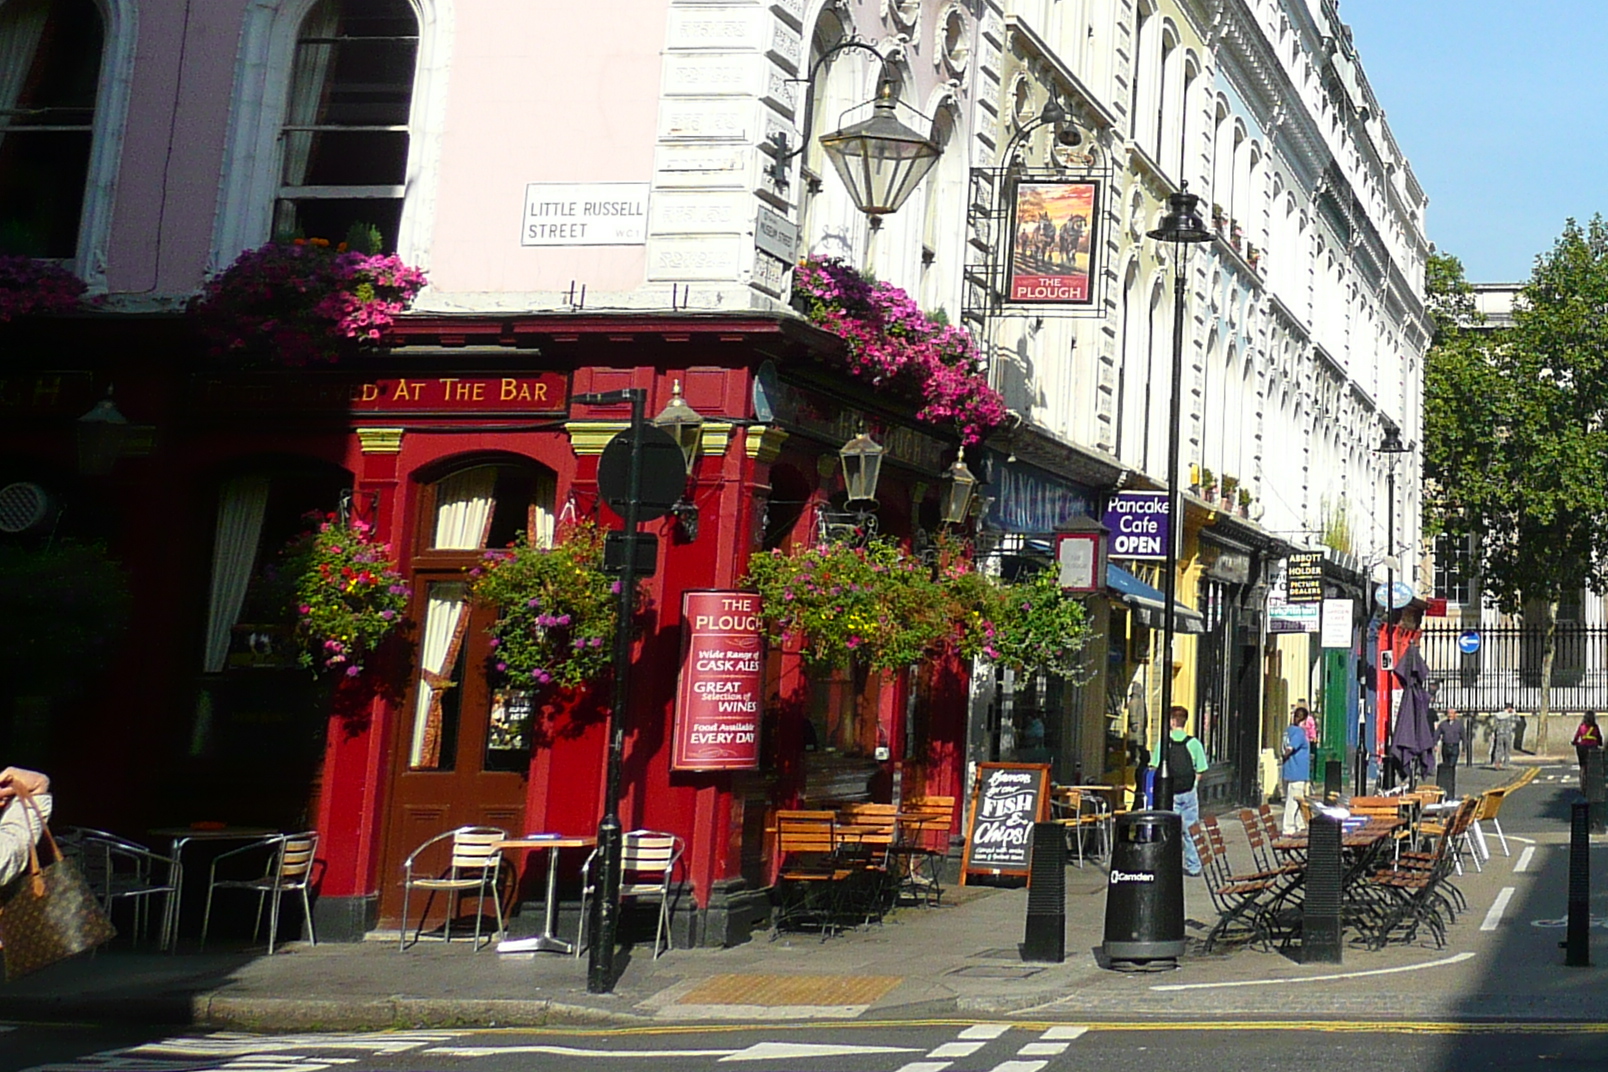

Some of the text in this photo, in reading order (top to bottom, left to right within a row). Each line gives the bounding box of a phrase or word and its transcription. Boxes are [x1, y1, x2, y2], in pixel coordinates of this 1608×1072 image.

[530, 201, 644, 217] LITTLE RUSSELL
[528, 223, 640, 239] STREET WC1
[1038, 278, 1061, 287] THE
[1017, 287, 1081, 298] PLOUGH
[392, 378, 427, 402] AT
[439, 377, 487, 402] THE
[499, 377, 548, 402] BAR
[999, 466, 1063, 533] PANCAKE
[1107, 496, 1170, 514] Pancake
[1119, 515, 1158, 533] Cafe
[1114, 535, 1161, 553] OPEN
[1289, 554, 1322, 563] ABBOTT
[1288, 566, 1322, 575] HOLDER
[721, 599, 752, 612] THE
[695, 615, 763, 630] PLOUGH
[698, 650, 760, 661] Wide Range of
[696, 660, 760, 672] CASK ALES
[693, 681, 742, 693] GREAT
[701, 692, 751, 702] Selection of
[718, 701, 757, 713] WINES
[693, 723, 755, 732] Food Available
[690, 732, 756, 744] EVERY DAY
[981, 793, 1034, 818] FISH
[1005, 811, 1029, 827] &
[973, 821, 1035, 848] Chips!
[1118, 871, 1155, 882] Camden
